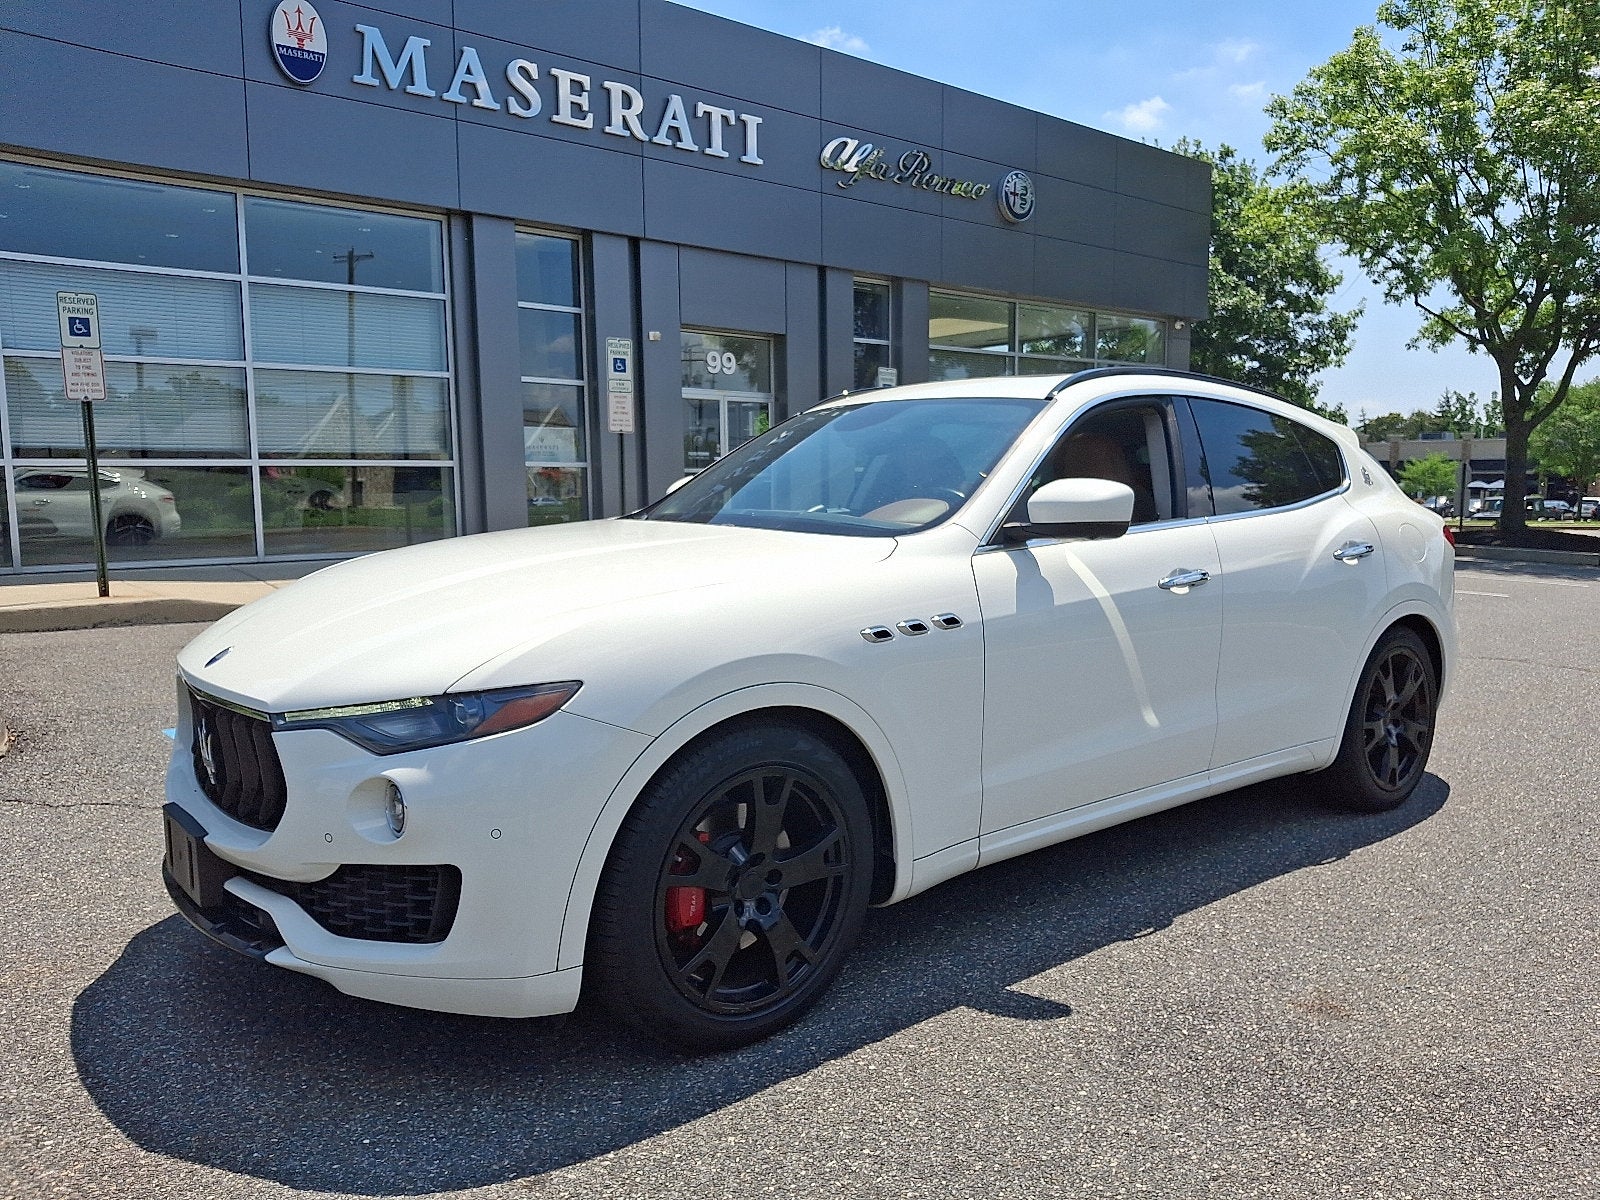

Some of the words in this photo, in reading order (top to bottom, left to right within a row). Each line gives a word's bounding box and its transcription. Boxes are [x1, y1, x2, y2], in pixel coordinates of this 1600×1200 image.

[279, 46, 322, 62] MASERATI
[353, 23, 764, 165] MASERATI
[820, 136, 893, 189] Alfa
[893, 149, 990, 200] Romeo
[59, 296, 96, 306] RESERVED
[62, 306, 94, 316] PARKING
[706, 351, 737, 375] 99
